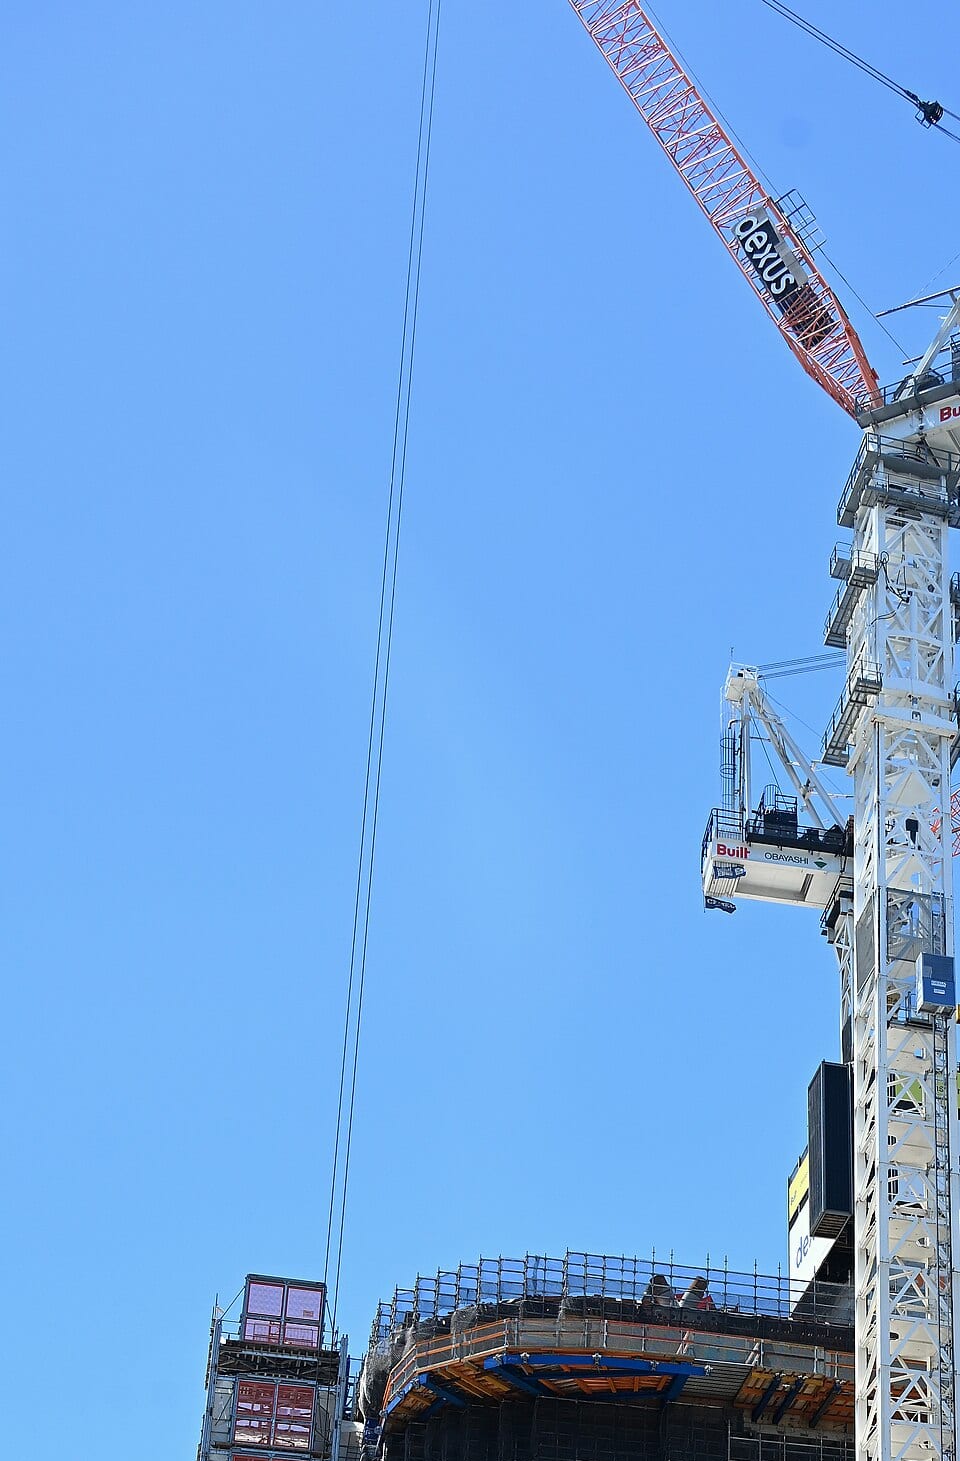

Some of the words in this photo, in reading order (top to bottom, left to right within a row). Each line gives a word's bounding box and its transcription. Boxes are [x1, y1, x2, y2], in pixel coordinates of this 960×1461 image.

[735, 216, 795, 294] dexus
[717, 844, 750, 859] Built
[764, 852, 808, 865] OBAYASHI
